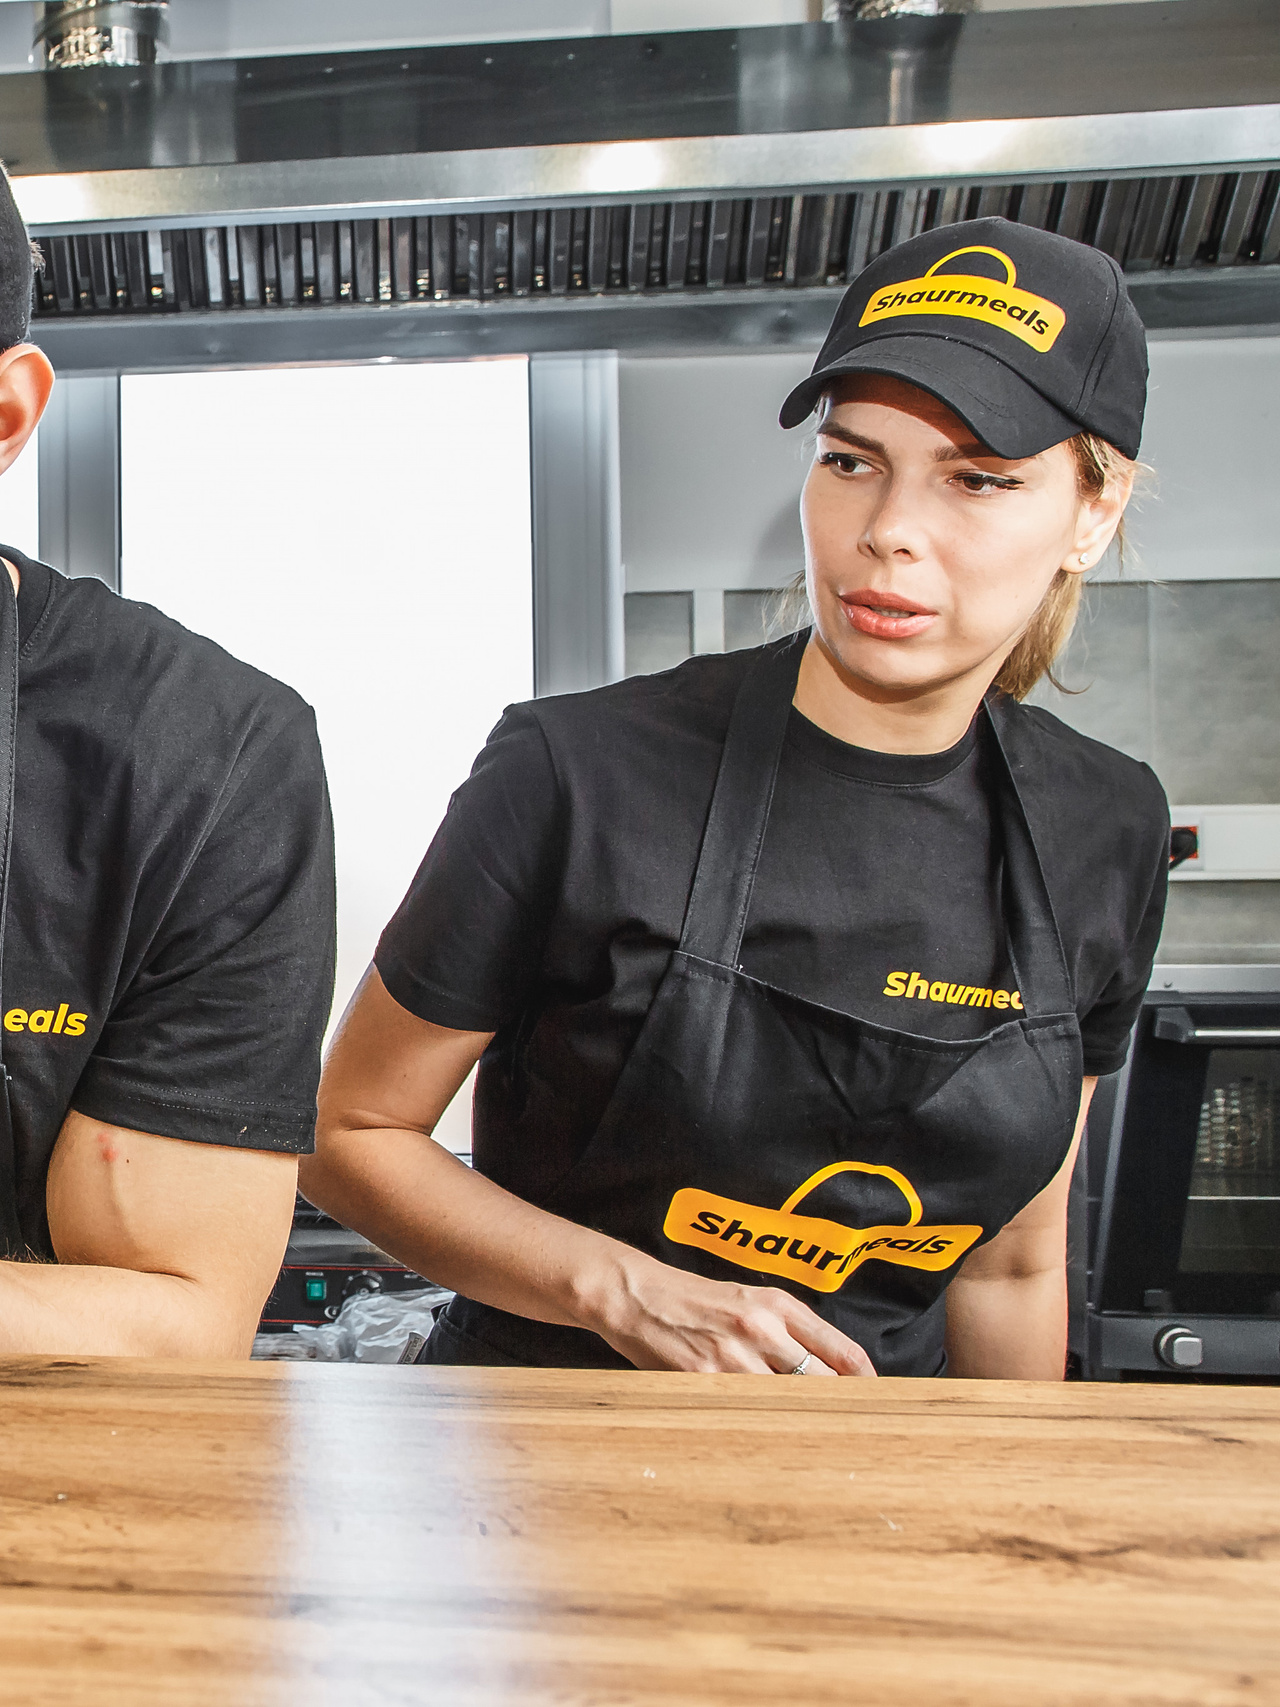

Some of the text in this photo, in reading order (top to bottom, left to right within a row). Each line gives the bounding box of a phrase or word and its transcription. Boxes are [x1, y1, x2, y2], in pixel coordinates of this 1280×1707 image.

[872, 289, 1049, 335] Shaurmeals
[882, 971, 1024, 1010] Shaurmea
[689, 1211, 954, 1274] Shaurmeals
